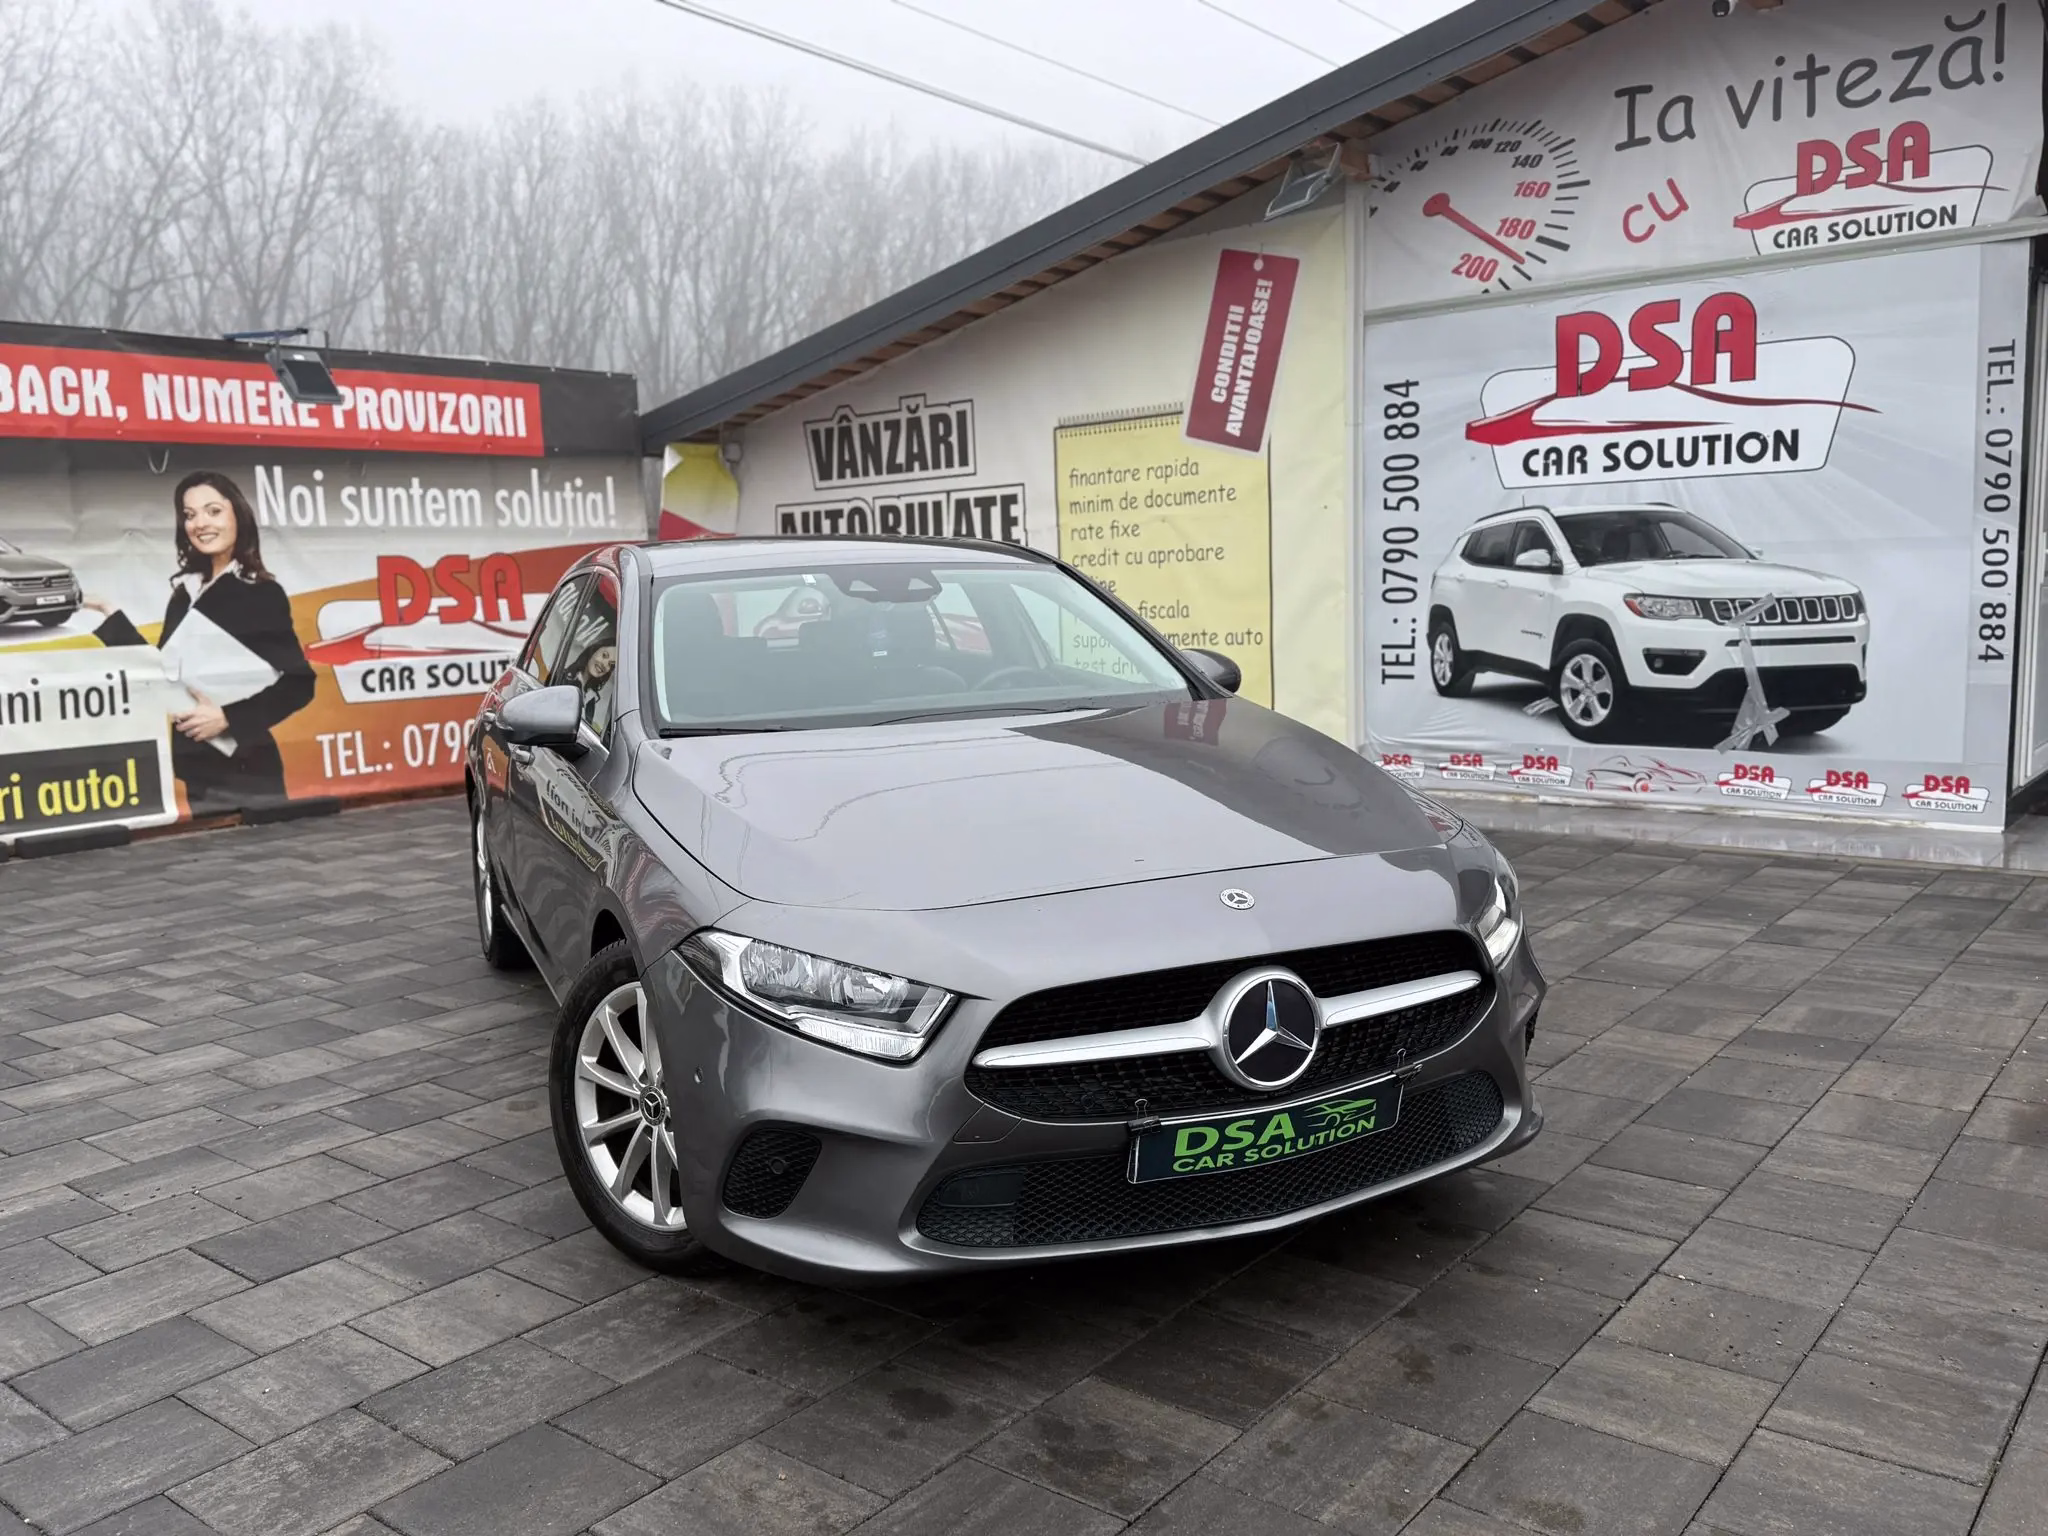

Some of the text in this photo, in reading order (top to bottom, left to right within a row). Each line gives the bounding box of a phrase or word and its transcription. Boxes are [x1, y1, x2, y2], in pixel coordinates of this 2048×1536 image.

[1614, 3, 2006, 152] Ia viteză!
[1493, 140, 1522, 153] 120
[1511, 154, 1544, 169] 140
[1796, 120, 1931, 197] DSA
[1513, 180, 1552, 199] 160
[1622, 177, 1690, 243] cu
[1772, 204, 1957, 249] CAR SOLUTION
[1495, 216, 1537, 240] 180
[1451, 252, 1499, 283] 200
[1210, 304, 1245, 403] CONDITII
[1225, 278, 1273, 437] AVANTAJOASE!
[1555, 291, 1757, 398] DSA
[332, 384, 527, 438] PROVIZORII
[811, 403, 969, 481] VÂNZĂRI
[1522, 428, 1800, 477] CAR SOLUTION
[1069, 457, 1200, 488] finantare rapida
[255, 465, 327, 527] Noi
[339, 477, 483, 527] suntem
[1069, 484, 1237, 514] minim de documente
[1977, 338, 2016, 663] TEL.: 0790 500 884
[1070, 520, 1141, 541] rate fixe
[1381, 379, 1420, 684] TEL.: 0790 500 884
[1071, 543, 1225, 569] credit cu aprobare
[376, 552, 527, 626] DSA
[1137, 599, 1190, 620] fiscala
[1224, 628, 1264, 646] auto
[361, 657, 512, 693] CAR SOLUT
[0, 669, 130, 725] ni noi!
[315, 730, 394, 778] TEL.:
[1450, 753, 1484, 767] DSA
[1522, 754, 1559, 771] DSA
[37, 758, 140, 817] auto!
[1532, 776, 1566, 785] SOLUTION
[1733, 763, 1775, 783] DSA
[1826, 769, 1869, 789] DSA
[1923, 774, 1971, 794] DSA
[1725, 787, 1782, 799] CAR SOLUTION
[1818, 793, 1877, 805] CAR SOLUTION
[1915, 799, 1978, 811] CAR SOLUTION
[1172, 1116, 1376, 1172] CAR SOLUTION
[1174, 1112, 1296, 1157] DSA
